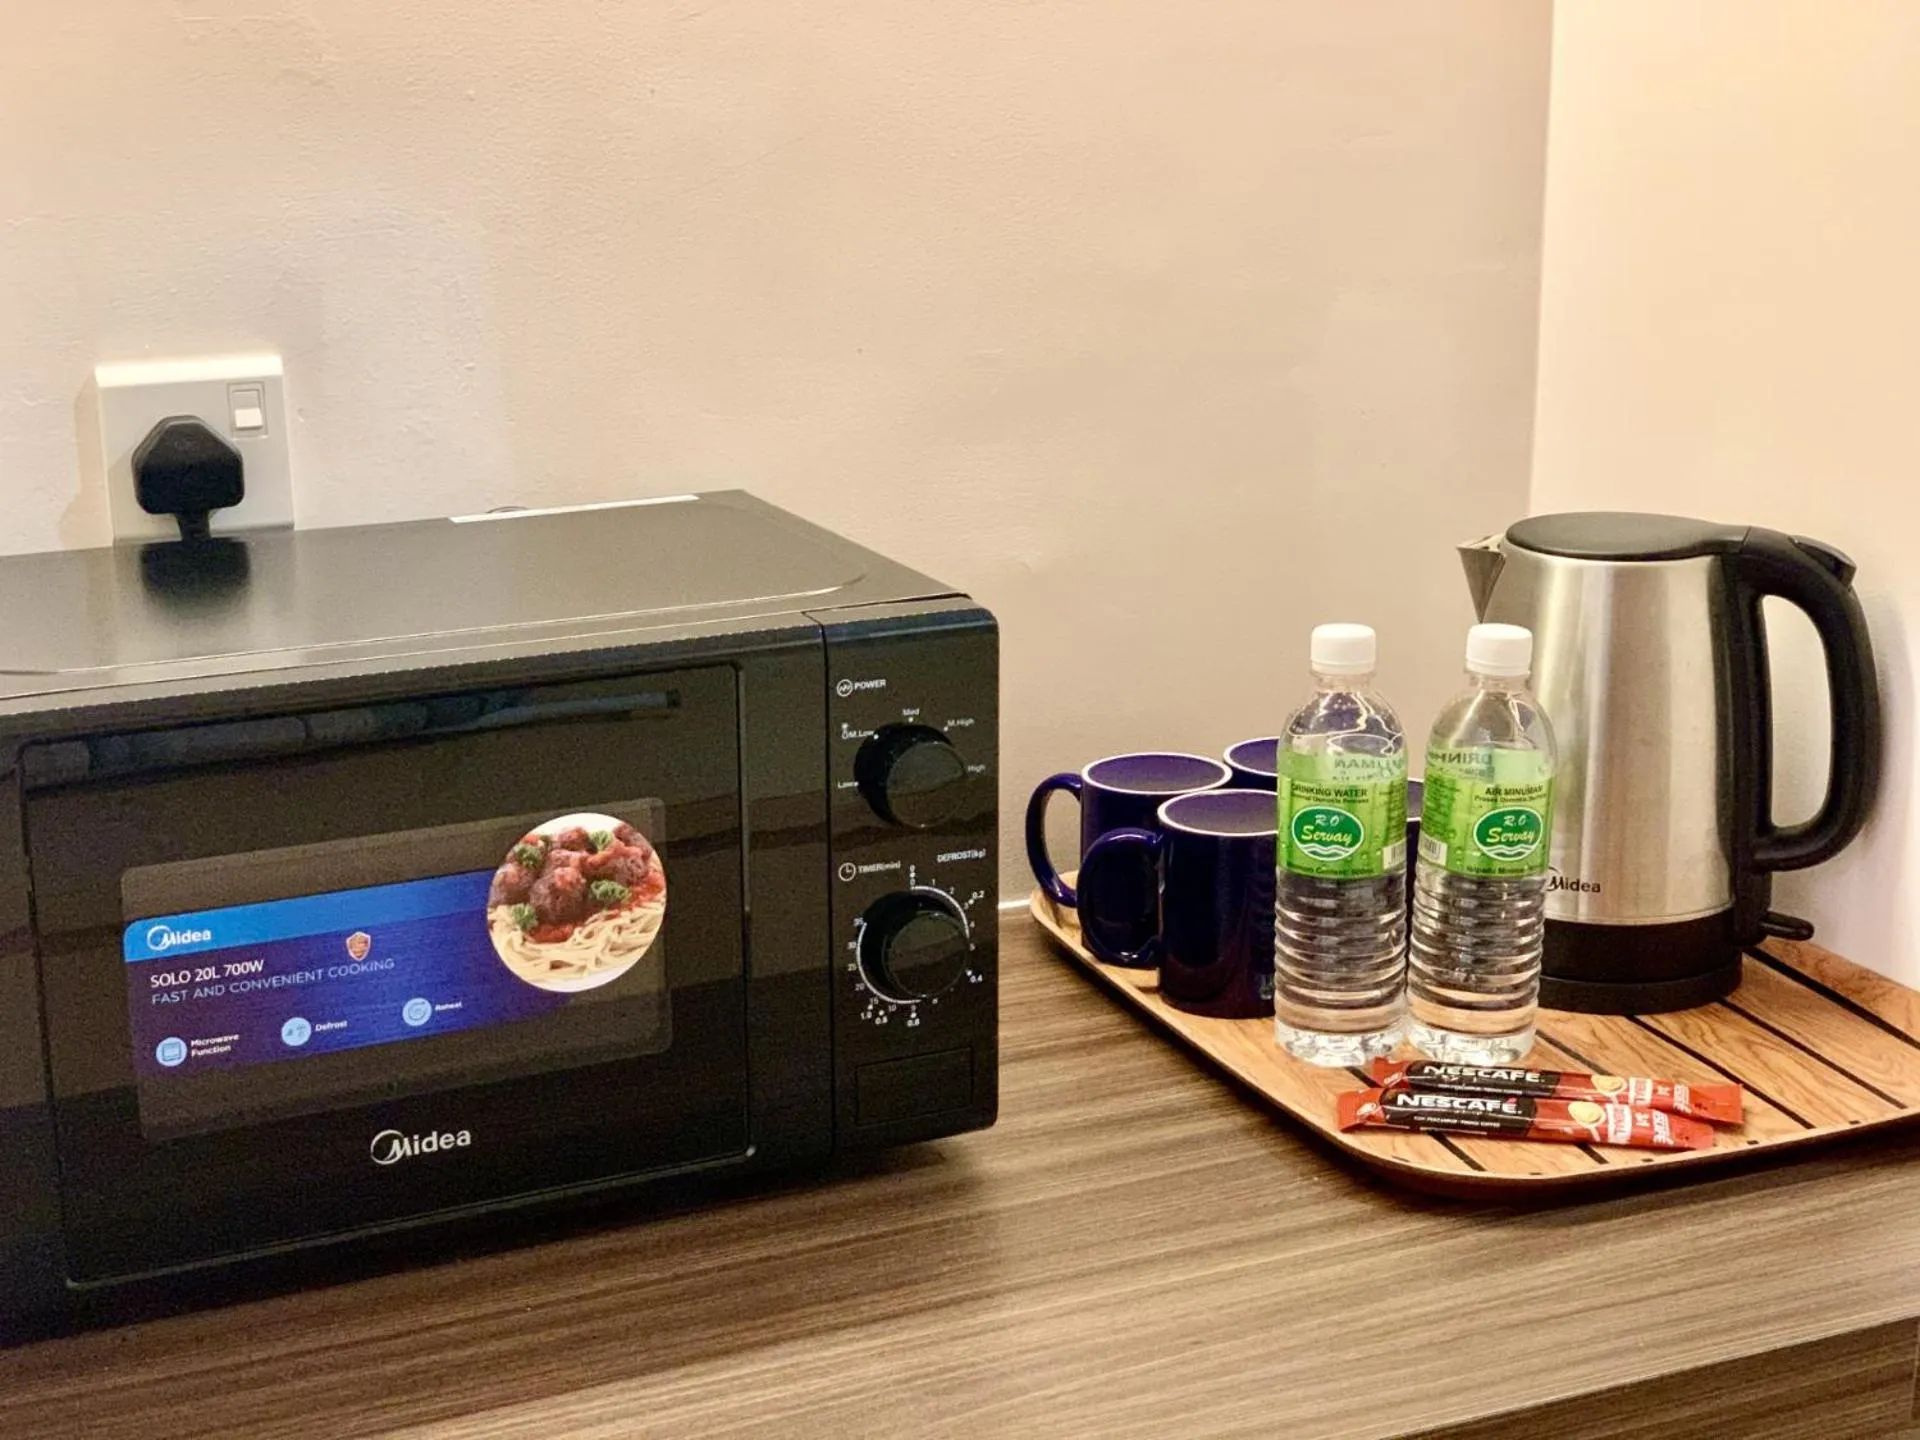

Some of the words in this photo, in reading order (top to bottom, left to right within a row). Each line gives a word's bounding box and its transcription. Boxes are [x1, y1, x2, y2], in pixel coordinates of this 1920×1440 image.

[854, 679, 887, 690] POWER
[968, 764, 986, 773] High
[1334, 787, 1368, 797] WATER
[1485, 785, 1502, 796] AIR
[1547, 871, 1601, 893] Midea
[972, 890, 985, 900] 0.2
[147, 925, 212, 951] Midea
[150, 971, 191, 988] SOLO
[194, 966, 221, 982] 20L
[224, 959, 265, 977] 700W
[970, 974, 983, 983] 0.4
[151, 990, 187, 1005] FAST
[193, 984, 225, 999] AND
[229, 970, 325, 992] CONVENIENT
[328, 958, 396, 978] COOKING
[315, 1020, 347, 1032] Defrost
[190, 1033, 239, 1047] Microwave
[190, 1044, 231, 1057] Function
[370, 1129, 471, 1165] Midea
